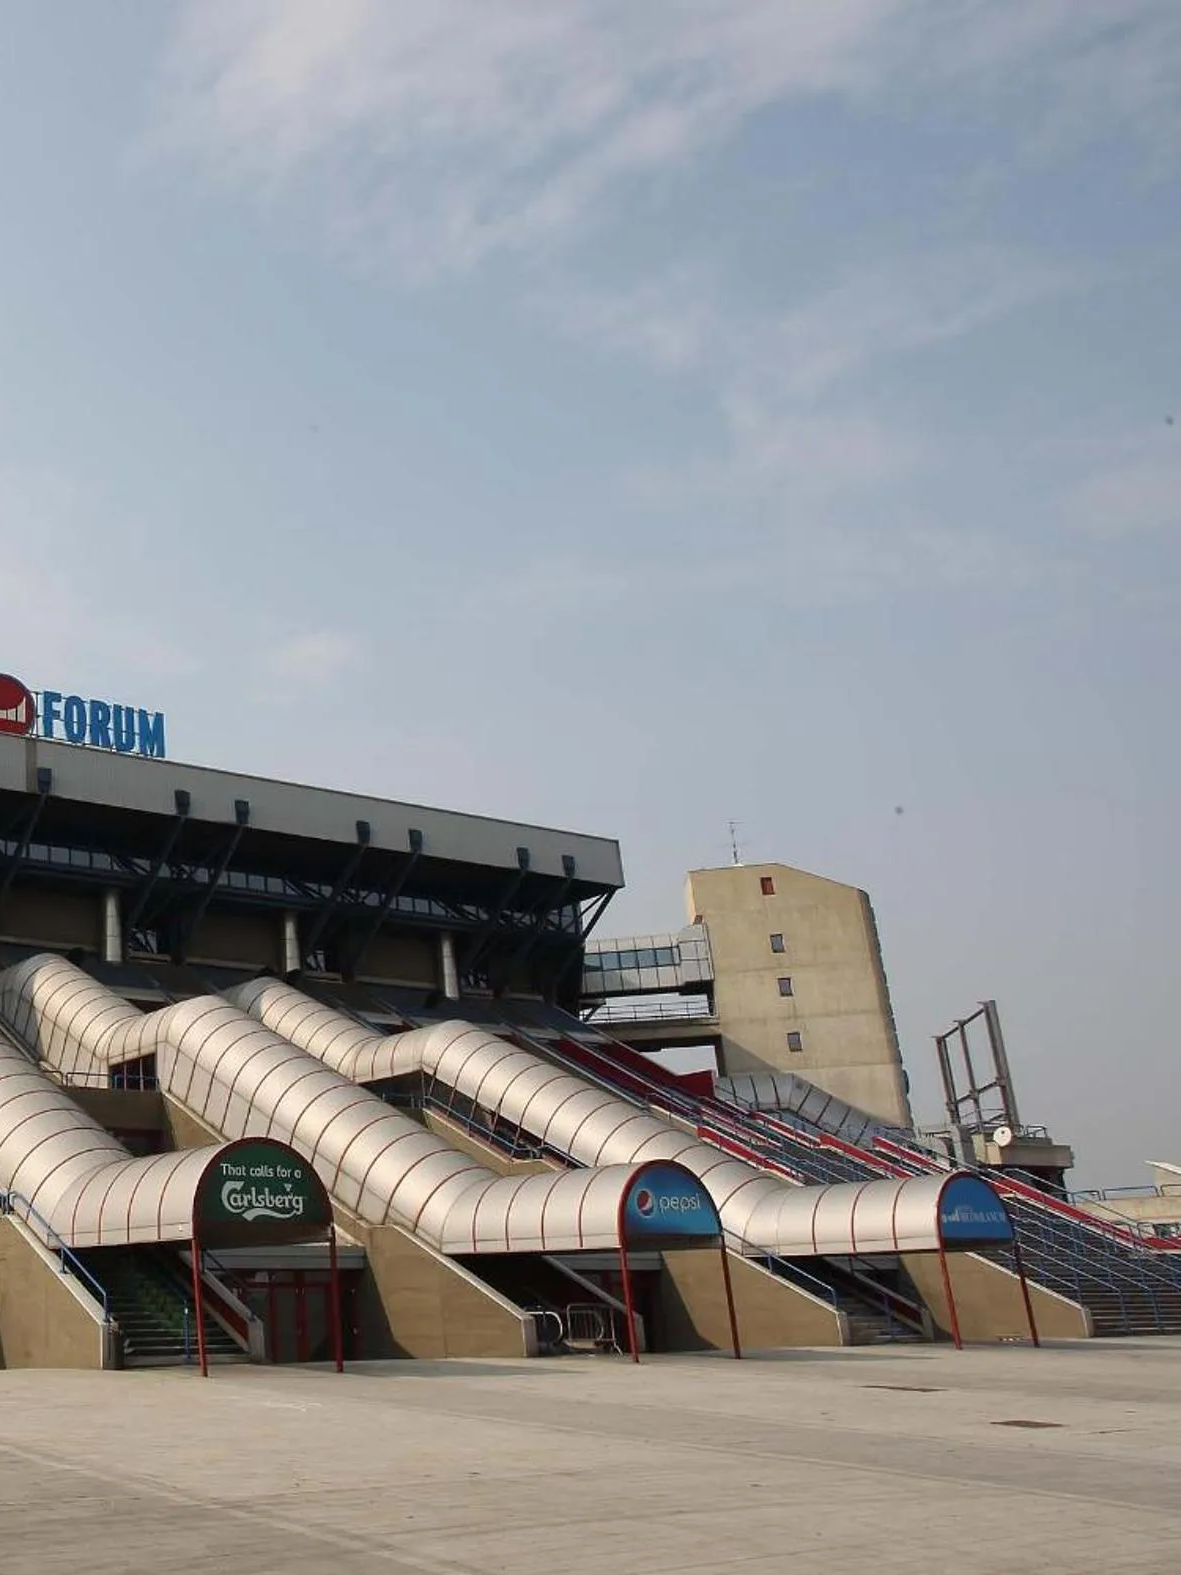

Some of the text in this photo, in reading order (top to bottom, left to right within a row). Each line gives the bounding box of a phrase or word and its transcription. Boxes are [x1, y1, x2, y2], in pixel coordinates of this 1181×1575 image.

[41, 691, 167, 758] FORUM
[220, 1163, 302, 1179] That calls for a
[221, 1180, 304, 1220] Carlsberg
[659, 1193, 701, 1214] pepsi
